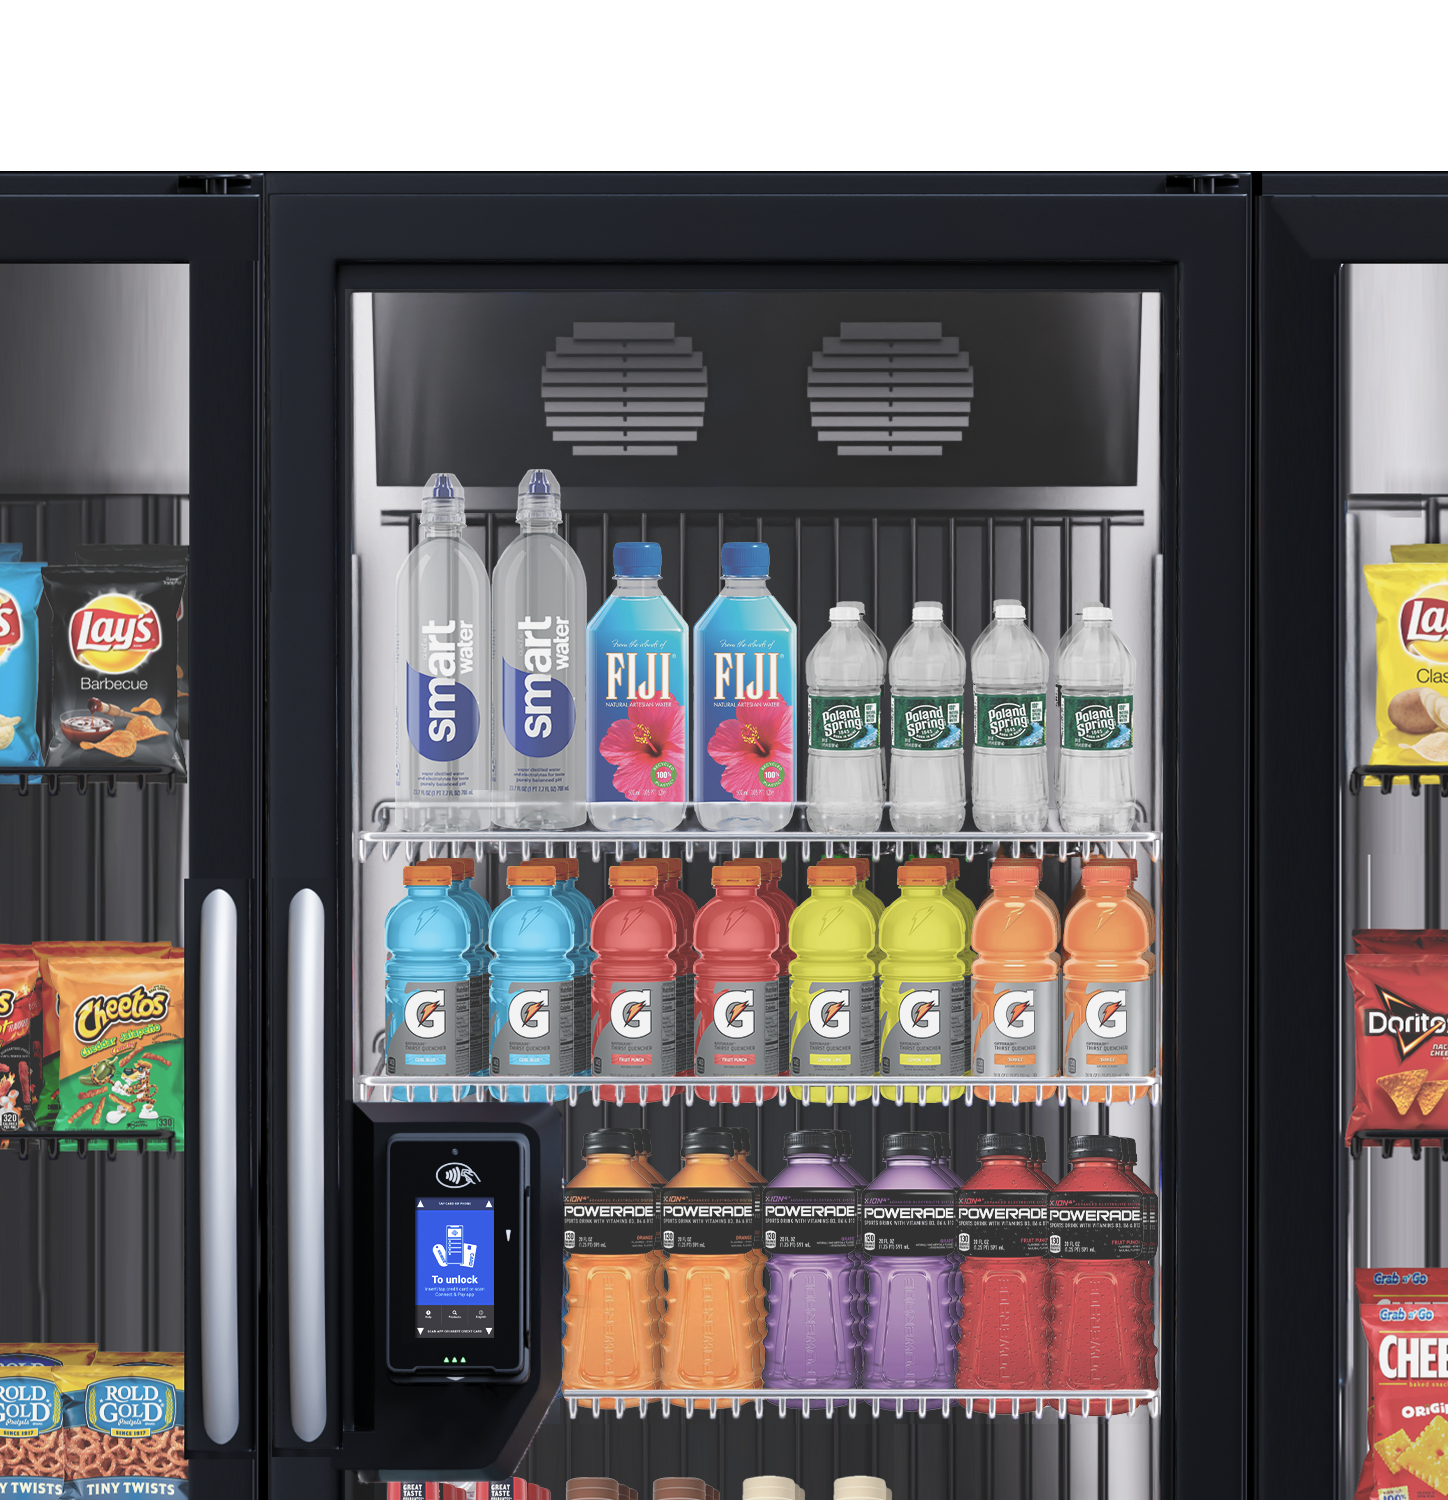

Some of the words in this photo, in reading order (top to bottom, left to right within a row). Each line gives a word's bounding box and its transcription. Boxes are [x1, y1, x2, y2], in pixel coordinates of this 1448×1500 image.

[460, 620, 474, 674] water
[422, 620, 456, 742] smart
[606, 652, 671, 700] FIJI
[714, 652, 779, 700] FIJI
[822, 706, 860, 724] Poland
[824, 718, 862, 738] Spring
[988, 704, 1026, 721] Poland
[990, 716, 1028, 735] Spring
[404, 989, 446, 1039] G
[610, 989, 652, 1039] G
[809, 989, 851, 1039] G
[994, 989, 1036, 1039] G
[564, 1206, 653, 1216] POWERADE
[766, 1206, 855, 1217] POWERADE
[1050, 1210, 1140, 1221] POWERADE
[432, 1275, 443, 1284] To
[446, 1275, 478, 1284] unlock
